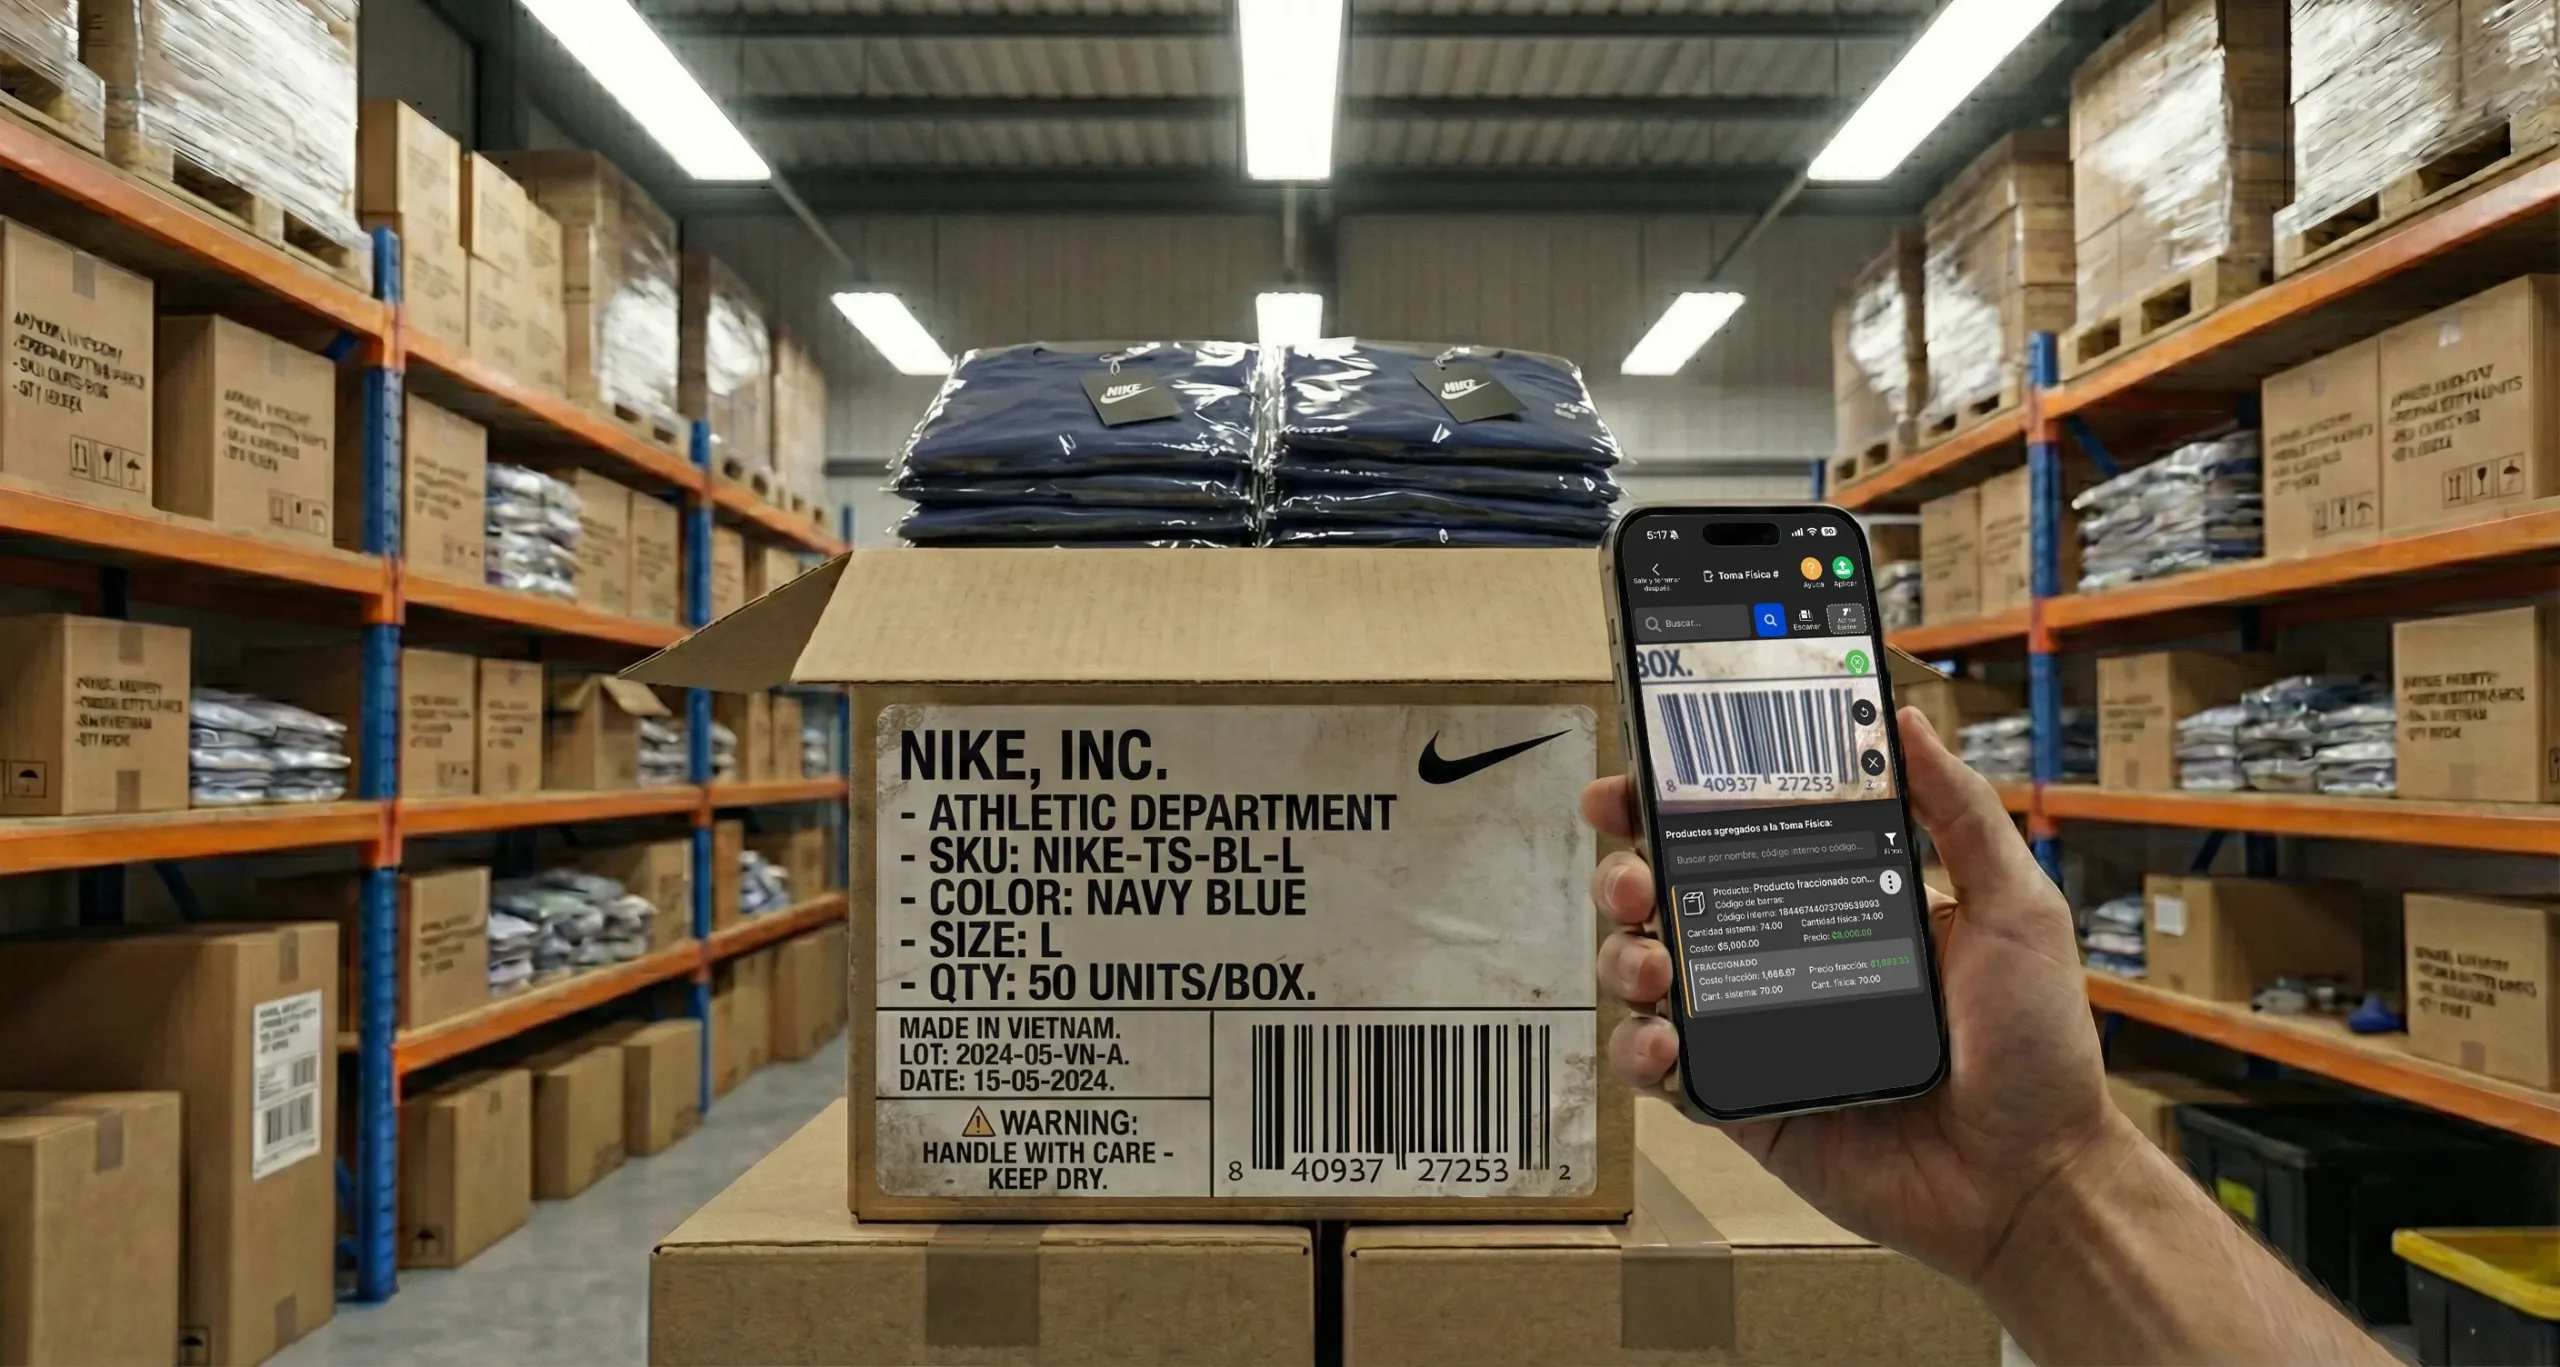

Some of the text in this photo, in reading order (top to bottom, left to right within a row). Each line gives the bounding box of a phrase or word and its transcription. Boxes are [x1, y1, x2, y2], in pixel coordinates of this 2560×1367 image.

[1106, 383, 1142, 397] NIKE
[1646, 530, 1668, 540] 5:17
[1718, 569, 1780, 580] Toma Física #
[901, 729, 1168, 790] NIKE, INC.
[1666, 779, 1677, 792] 8
[1703, 777, 1757, 793] 40937
[1778, 776, 1835, 792] 27253
[929, 794, 1116, 832] ATHLETIC
[1131, 794, 1398, 832] DEPARTMENT
[1666, 819, 1833, 839] Productos agregados a la Toma Física:
[930, 836, 1020, 874] SKU:
[1034, 836, 1305, 874] NIKE-TS-BL-L
[1677, 855, 1706, 865] Buscar
[1708, 854, 1722, 864] por
[1724, 851, 1759, 861] nombre,
[1713, 886, 1752, 897] Producto:
[1753, 881, 1795, 893] Producto
[1797, 876, 1850, 889] fraccionado
[931, 879, 1074, 916] COLOR:
[1088, 879, 1193, 916] NAVY
[1207, 879, 1307, 916] BLUE
[1715, 896, 1785, 910] Código de barras:
[1717, 912, 1745, 923] Código
[1801, 916, 1835, 927] Cantidad
[1861, 912, 1884, 921] 74.00
[1687, 921, 1783, 938] Cantidad sistema: 74.00
[1803, 933, 1830, 942] Precio:
[930, 921, 1027, 958] SIZE:
[1042, 921, 1063, 958] L
[1689, 944, 1716, 954] Costo:
[1694, 958, 1758, 972] FRACCIONADO
[1809, 963, 1834, 974] Precio
[931, 963, 1016, 1004] QTY:
[1029, 963, 1076, 1001] 50
[1090, 963, 1316, 1002] UNITS/BOX.
[1699, 976, 1723, 986] Costo
[1858, 974, 1881, 985] 70.00
[1701, 991, 1724, 1002] Cant.
[1759, 985, 1784, 995] 70.00
[901, 1016, 1121, 1040] MADE IN VIETNAM.
[900, 1043, 1130, 1066] LOT: 2024-05-VN-A.
[900, 1069, 1115, 1092] DATE: 15-05-2024.
[1000, 1110, 1138, 1136] WARNING:
[923, 1142, 1017, 1164] HANDLE
[1024, 1142, 1085, 1164] WITH
[1093, 1142, 1156, 1164] CARE
[988, 1168, 1108, 1190] KEEP DRY.
[1228, 1158, 1571, 1184] 8 40937 27253 2
